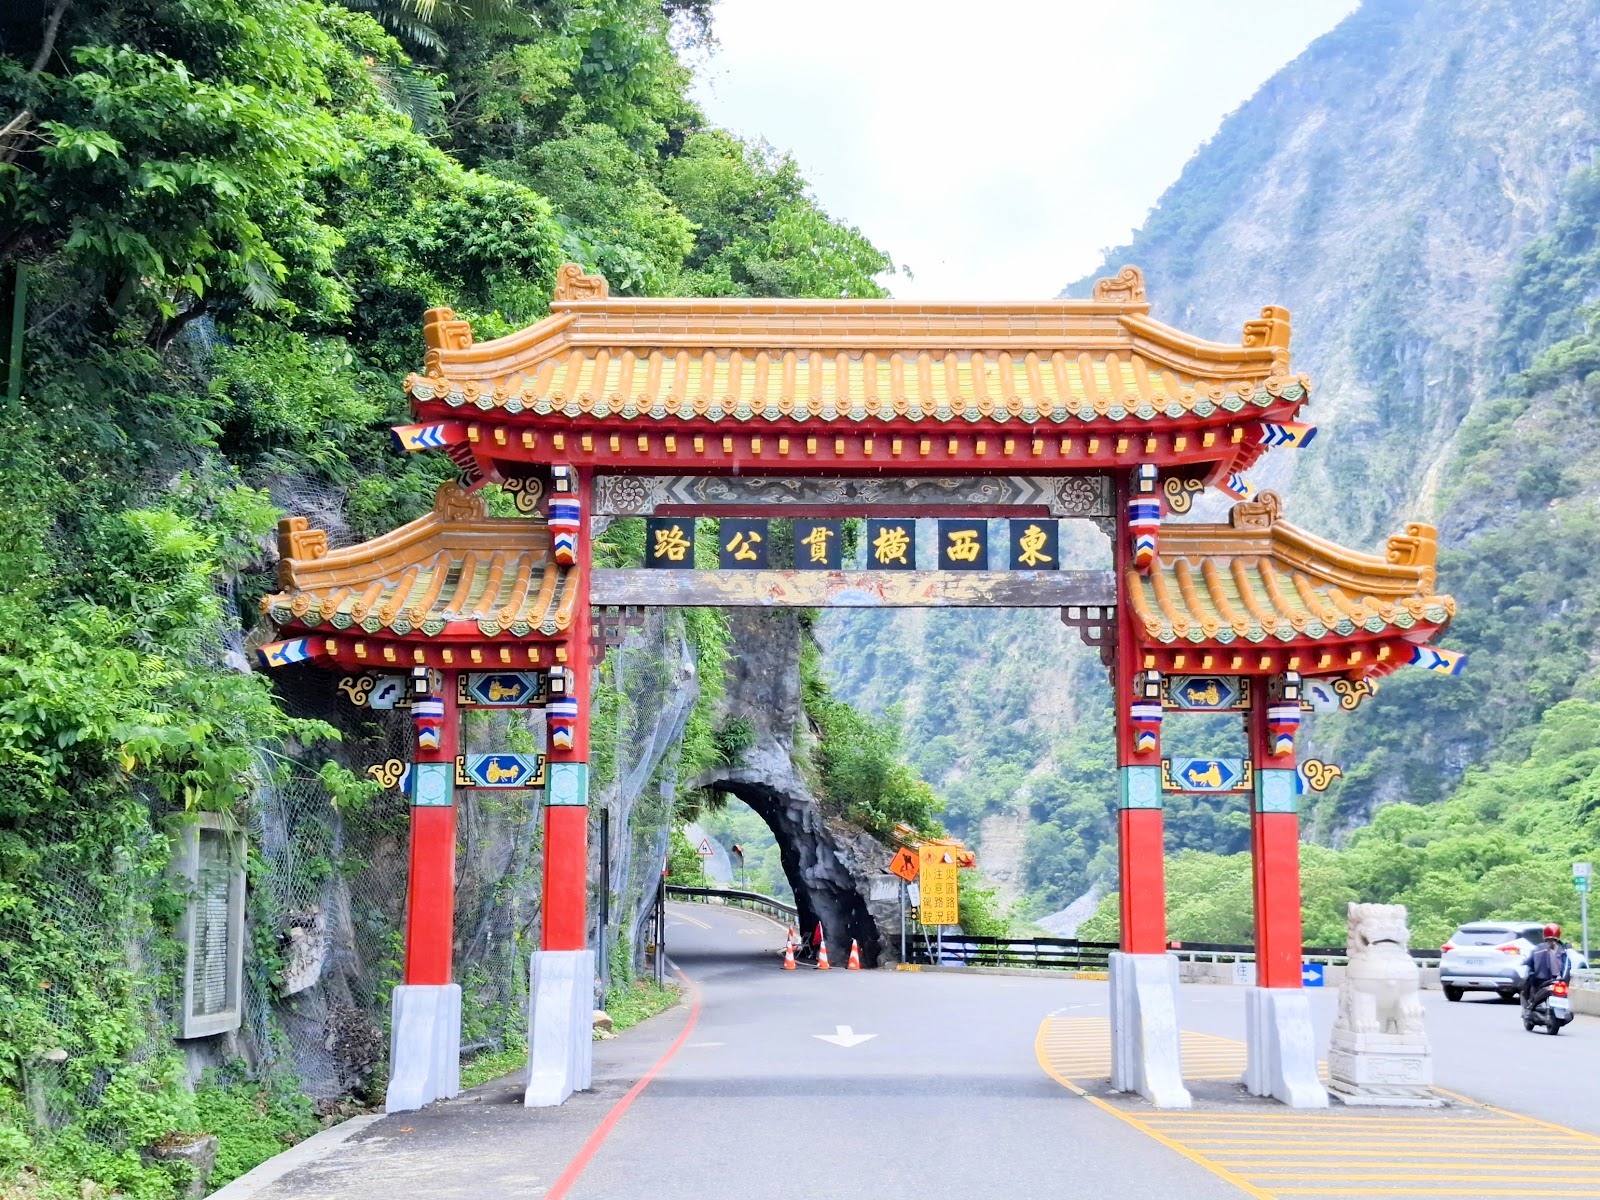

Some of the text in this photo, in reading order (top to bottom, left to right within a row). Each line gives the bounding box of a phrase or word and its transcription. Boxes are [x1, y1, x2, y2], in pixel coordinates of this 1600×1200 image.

[933, 868, 944, 922] 注意路況
[945, 868, 956, 922] 災區路段
